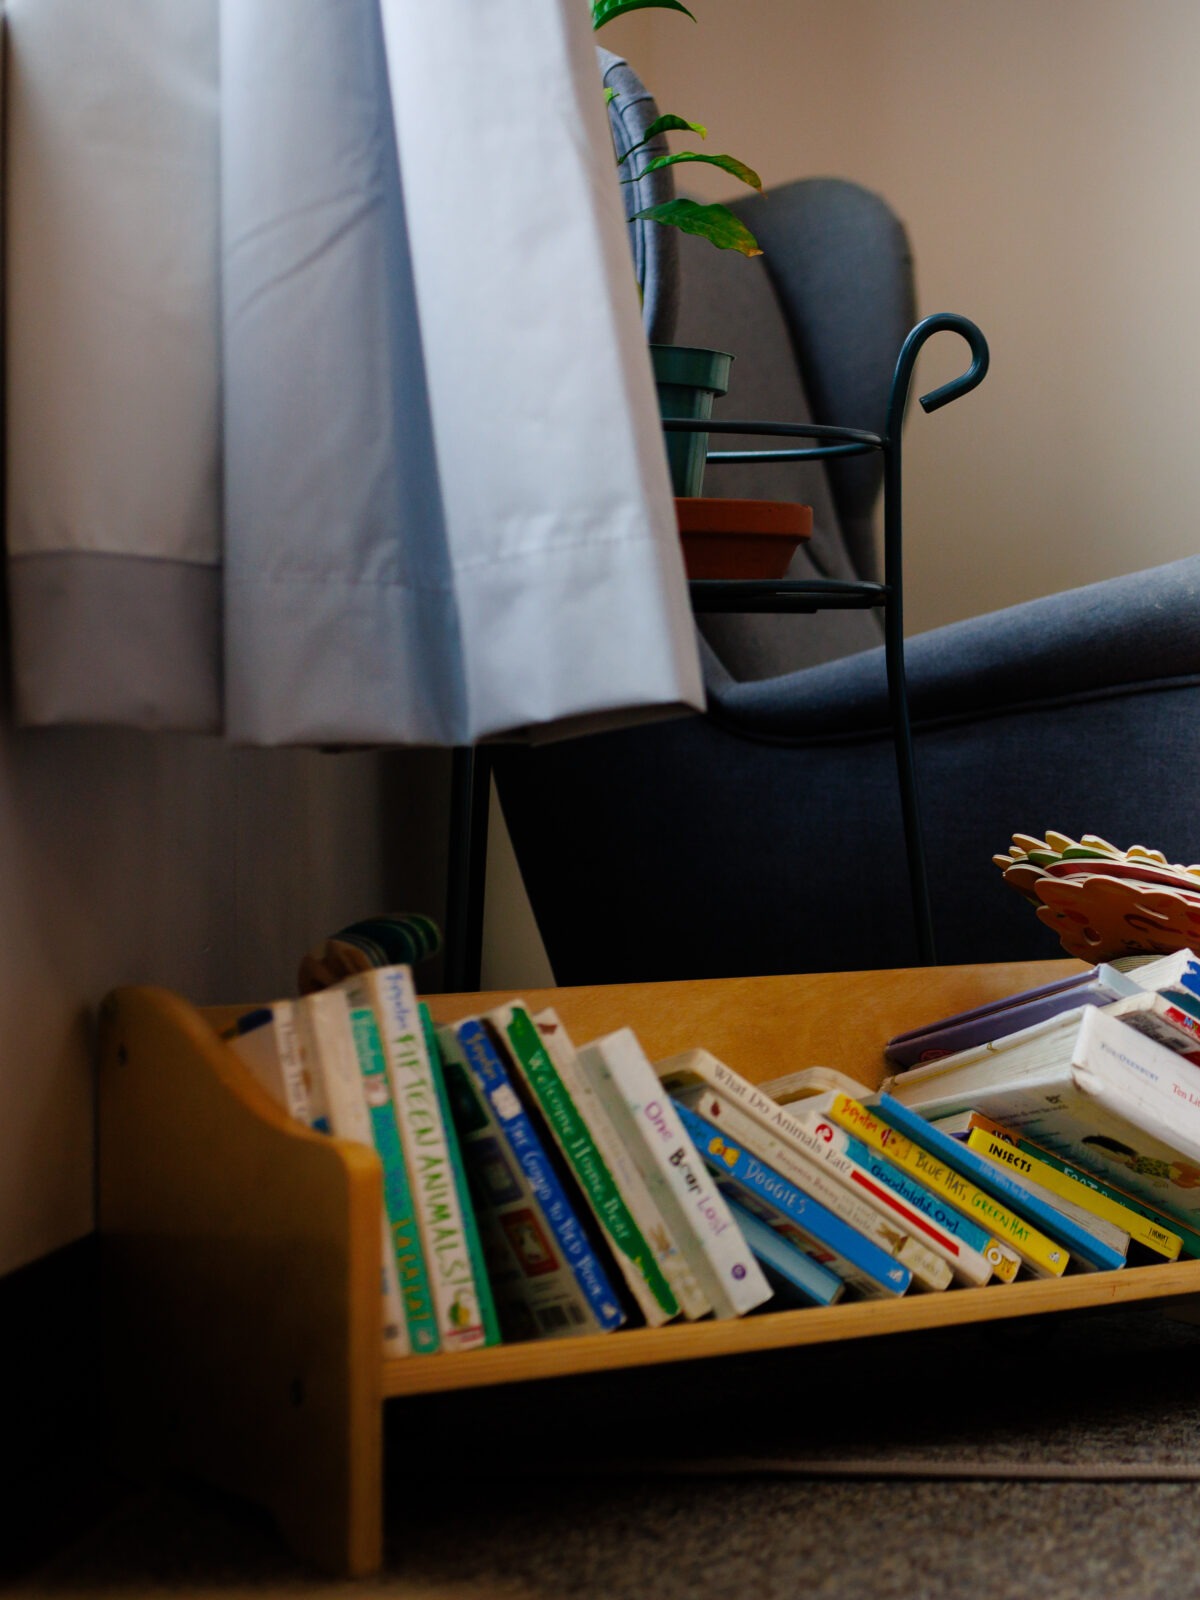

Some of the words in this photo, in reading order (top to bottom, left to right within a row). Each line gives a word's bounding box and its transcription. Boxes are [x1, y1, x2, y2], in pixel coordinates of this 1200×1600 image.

[393, 1034, 441, 1147] FIFTEEN
[714, 1064, 747, 1099] What
[748, 1091, 771, 1116] Do
[772, 1111, 823, 1155] Animals
[824, 1148, 853, 1175] Eat?
[1172, 1083, 1188, 1100] Ten
[528, 1050, 574, 1135] Welcome
[602, 1198, 631, 1241] Bear
[643, 1101, 674, 1143] One
[669, 1147, 703, 1195] Bear
[697, 1196, 728, 1237] Lost
[988, 1142, 1033, 1174] INSECTS
[742, 1157, 808, 1215] DOGGIES
[915, 1150, 944, 1182] BLUE
[943, 1169, 968, 1201] HAT,
[971, 1192, 1008, 1228] GREEN
[1008, 1218, 1031, 1243] HAT
[933, 1207, 961, 1234] Owl
[558, 1217, 583, 1256] BED
